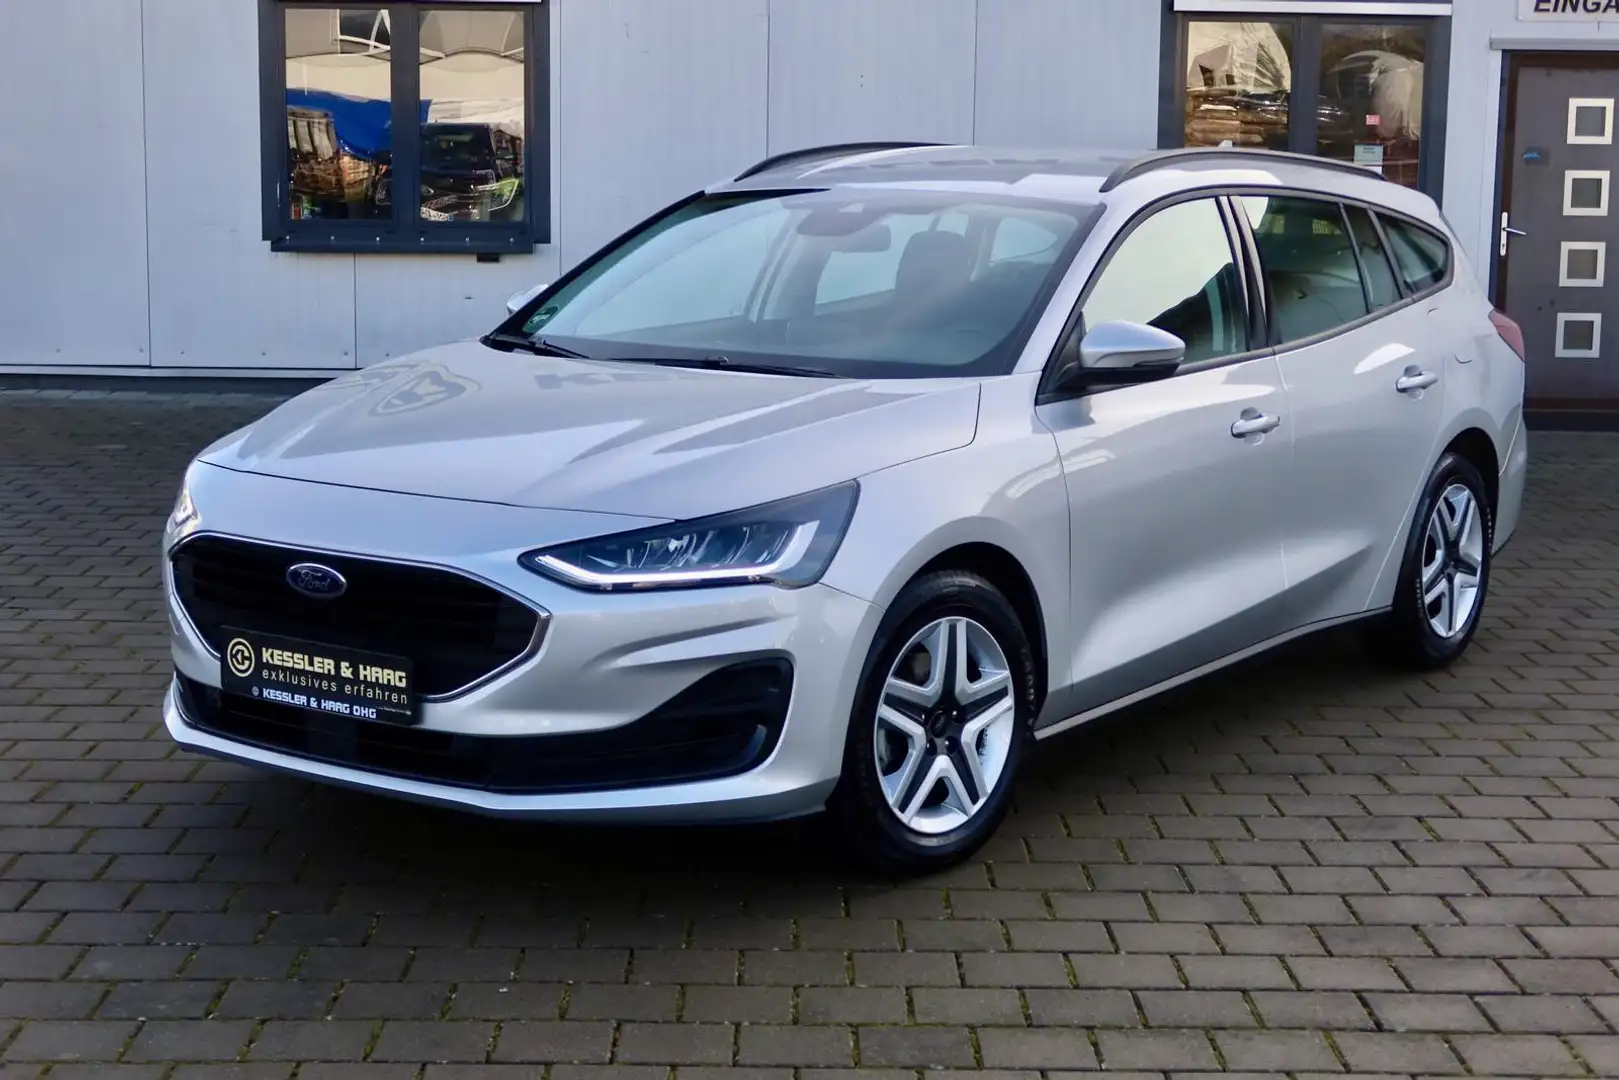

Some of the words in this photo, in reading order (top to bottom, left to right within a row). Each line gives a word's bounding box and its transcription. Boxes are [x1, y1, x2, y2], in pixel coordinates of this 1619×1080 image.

[298, 569, 331, 591] Ford
[261, 647, 335, 676] KESSLER
[340, 661, 354, 680] &
[358, 664, 407, 688] HAAG
[262, 668, 338, 692] exklusives
[344, 682, 408, 705] erfahren
[262, 687, 308, 706] KESSLER
[310, 697, 319, 709] &
[320, 699, 351, 714] HAAG
[352, 705, 377, 719] OHG
